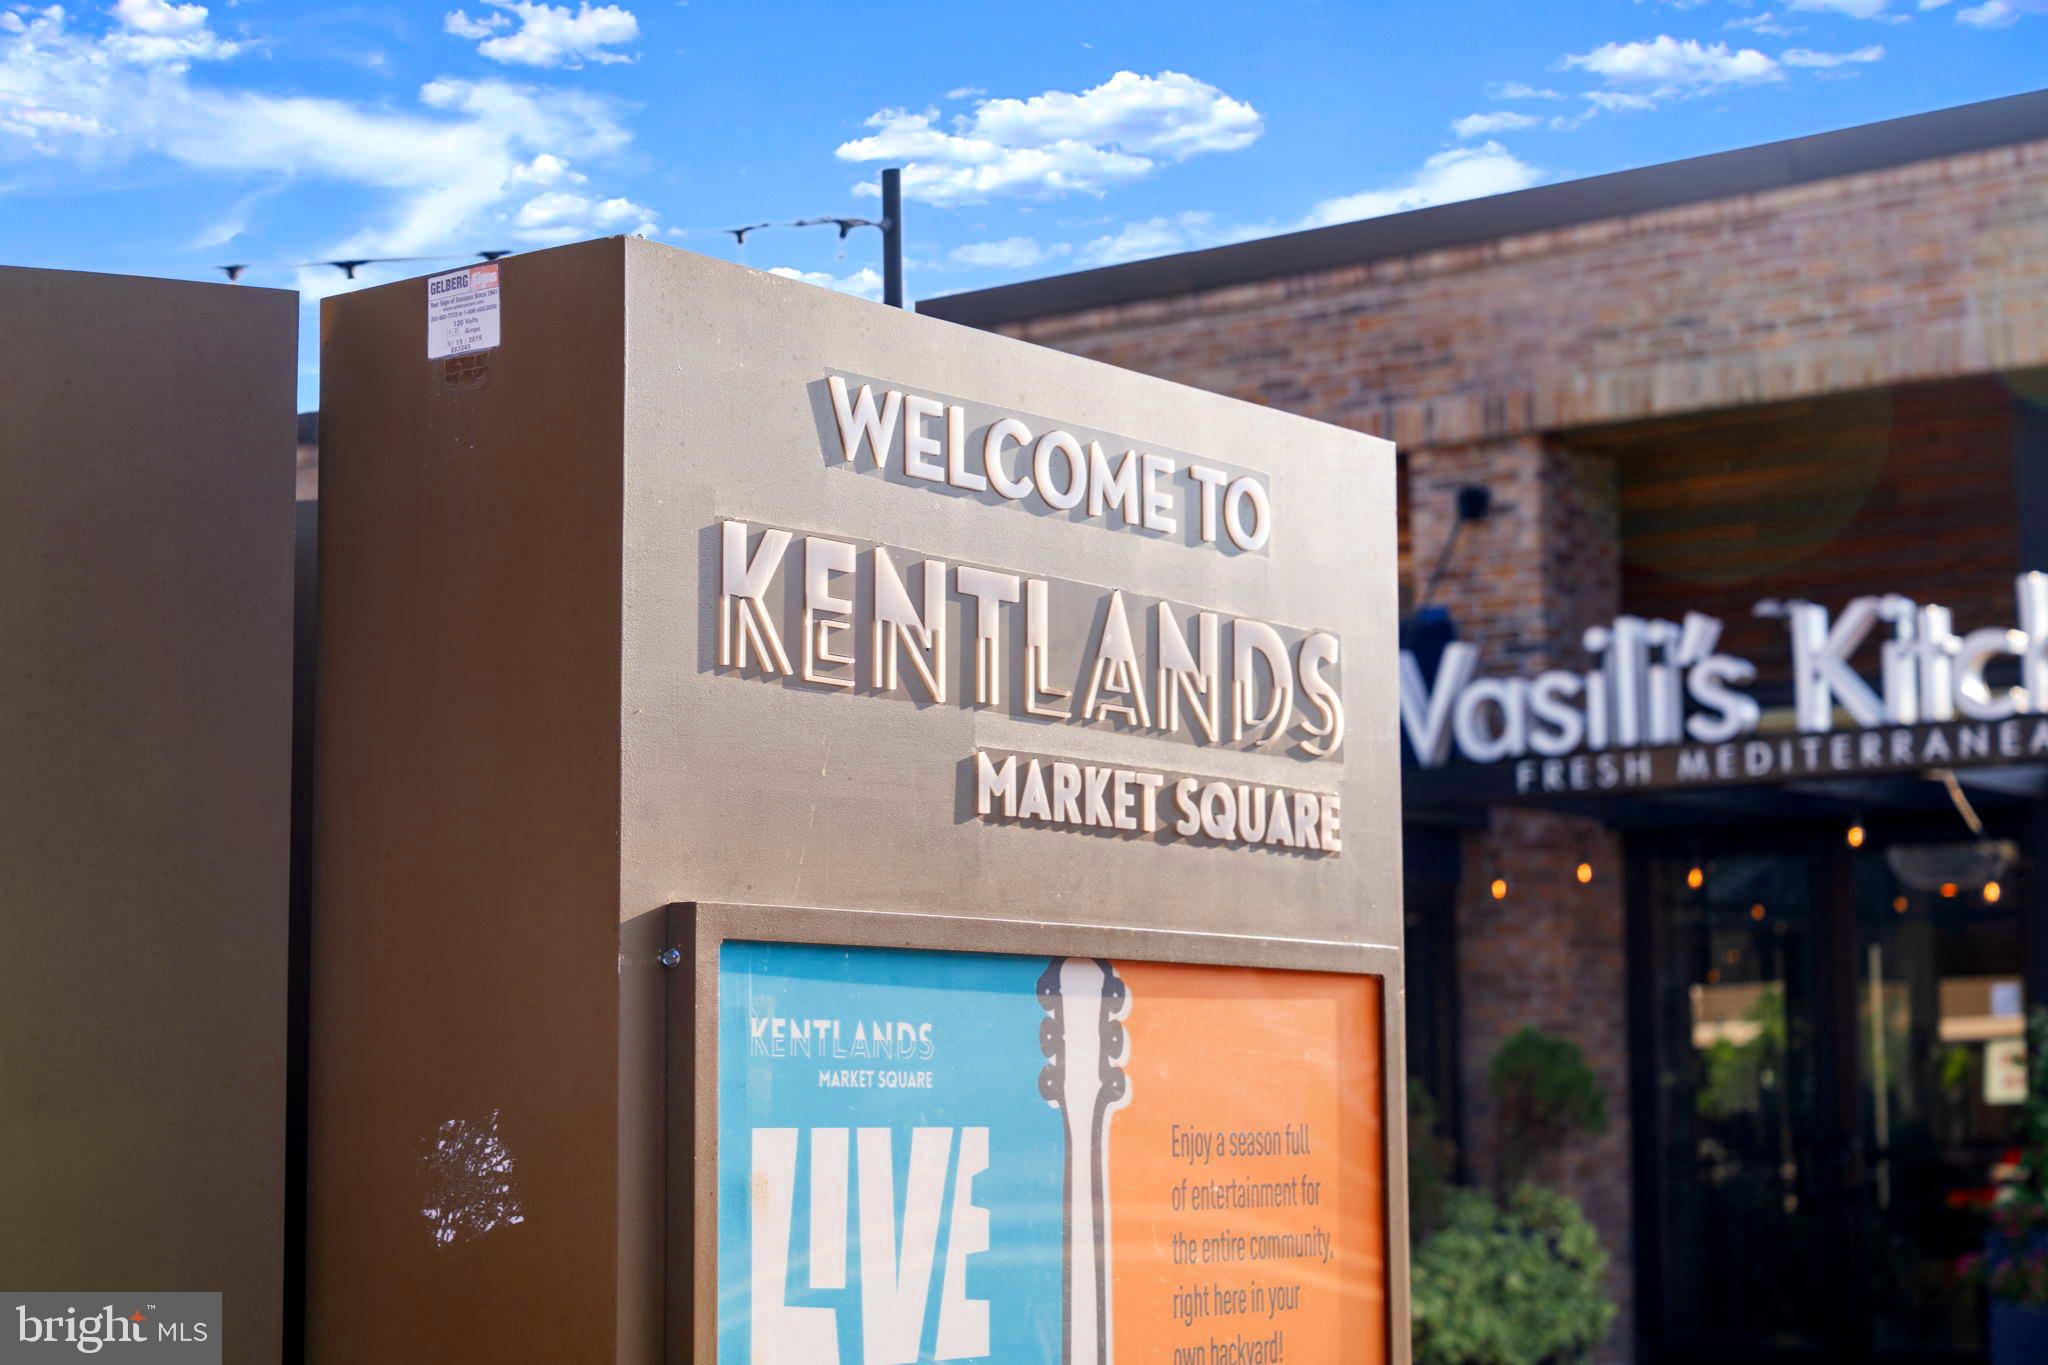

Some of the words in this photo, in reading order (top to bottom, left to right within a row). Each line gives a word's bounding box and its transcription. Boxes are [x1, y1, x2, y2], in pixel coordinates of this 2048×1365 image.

[430, 274, 468, 295] GELBERG
[453, 319, 464, 327] 120
[464, 317, 479, 325] Volts
[828, 374, 1177, 534] WELCOME
[1188, 463, 1271, 551] TO
[718, 518, 1346, 757] KENTLANDS
[1399, 609, 1760, 769] Vasili's
[1515, 754, 1652, 793] FRESH
[977, 750, 1164, 832] MARKET
[1176, 777, 1342, 852] SQUARE
[750, 1017, 935, 1061] KENTLANDS
[818, 1069, 874, 1088] MARKET
[878, 1070, 933, 1089] SQUARE
[1171, 1124, 1212, 1165] Enjoy
[1216, 1131, 1225, 1157] a
[1229, 1131, 1281, 1157] season
[1285, 1123, 1310, 1155] full
[1171, 1178, 1187, 1211] of
[1191, 1176, 1298, 1211] entertainment
[1301, 1174, 1321, 1206] for
[751, 1126, 990, 1365] LIVE
[1172, 1231, 1197, 1265] the
[1202, 1229, 1245, 1263] entire
[1250, 1225, 1334, 1264] community,
[1172, 1283, 1210, 1327] right
[1214, 1282, 1247, 1316] here
[1251, 1280, 1264, 1313] in
[1268, 1284, 1301, 1320] your
[1173, 1345, 1205, 1365] own
[1210, 1330, 1283, 1365] backyard!
